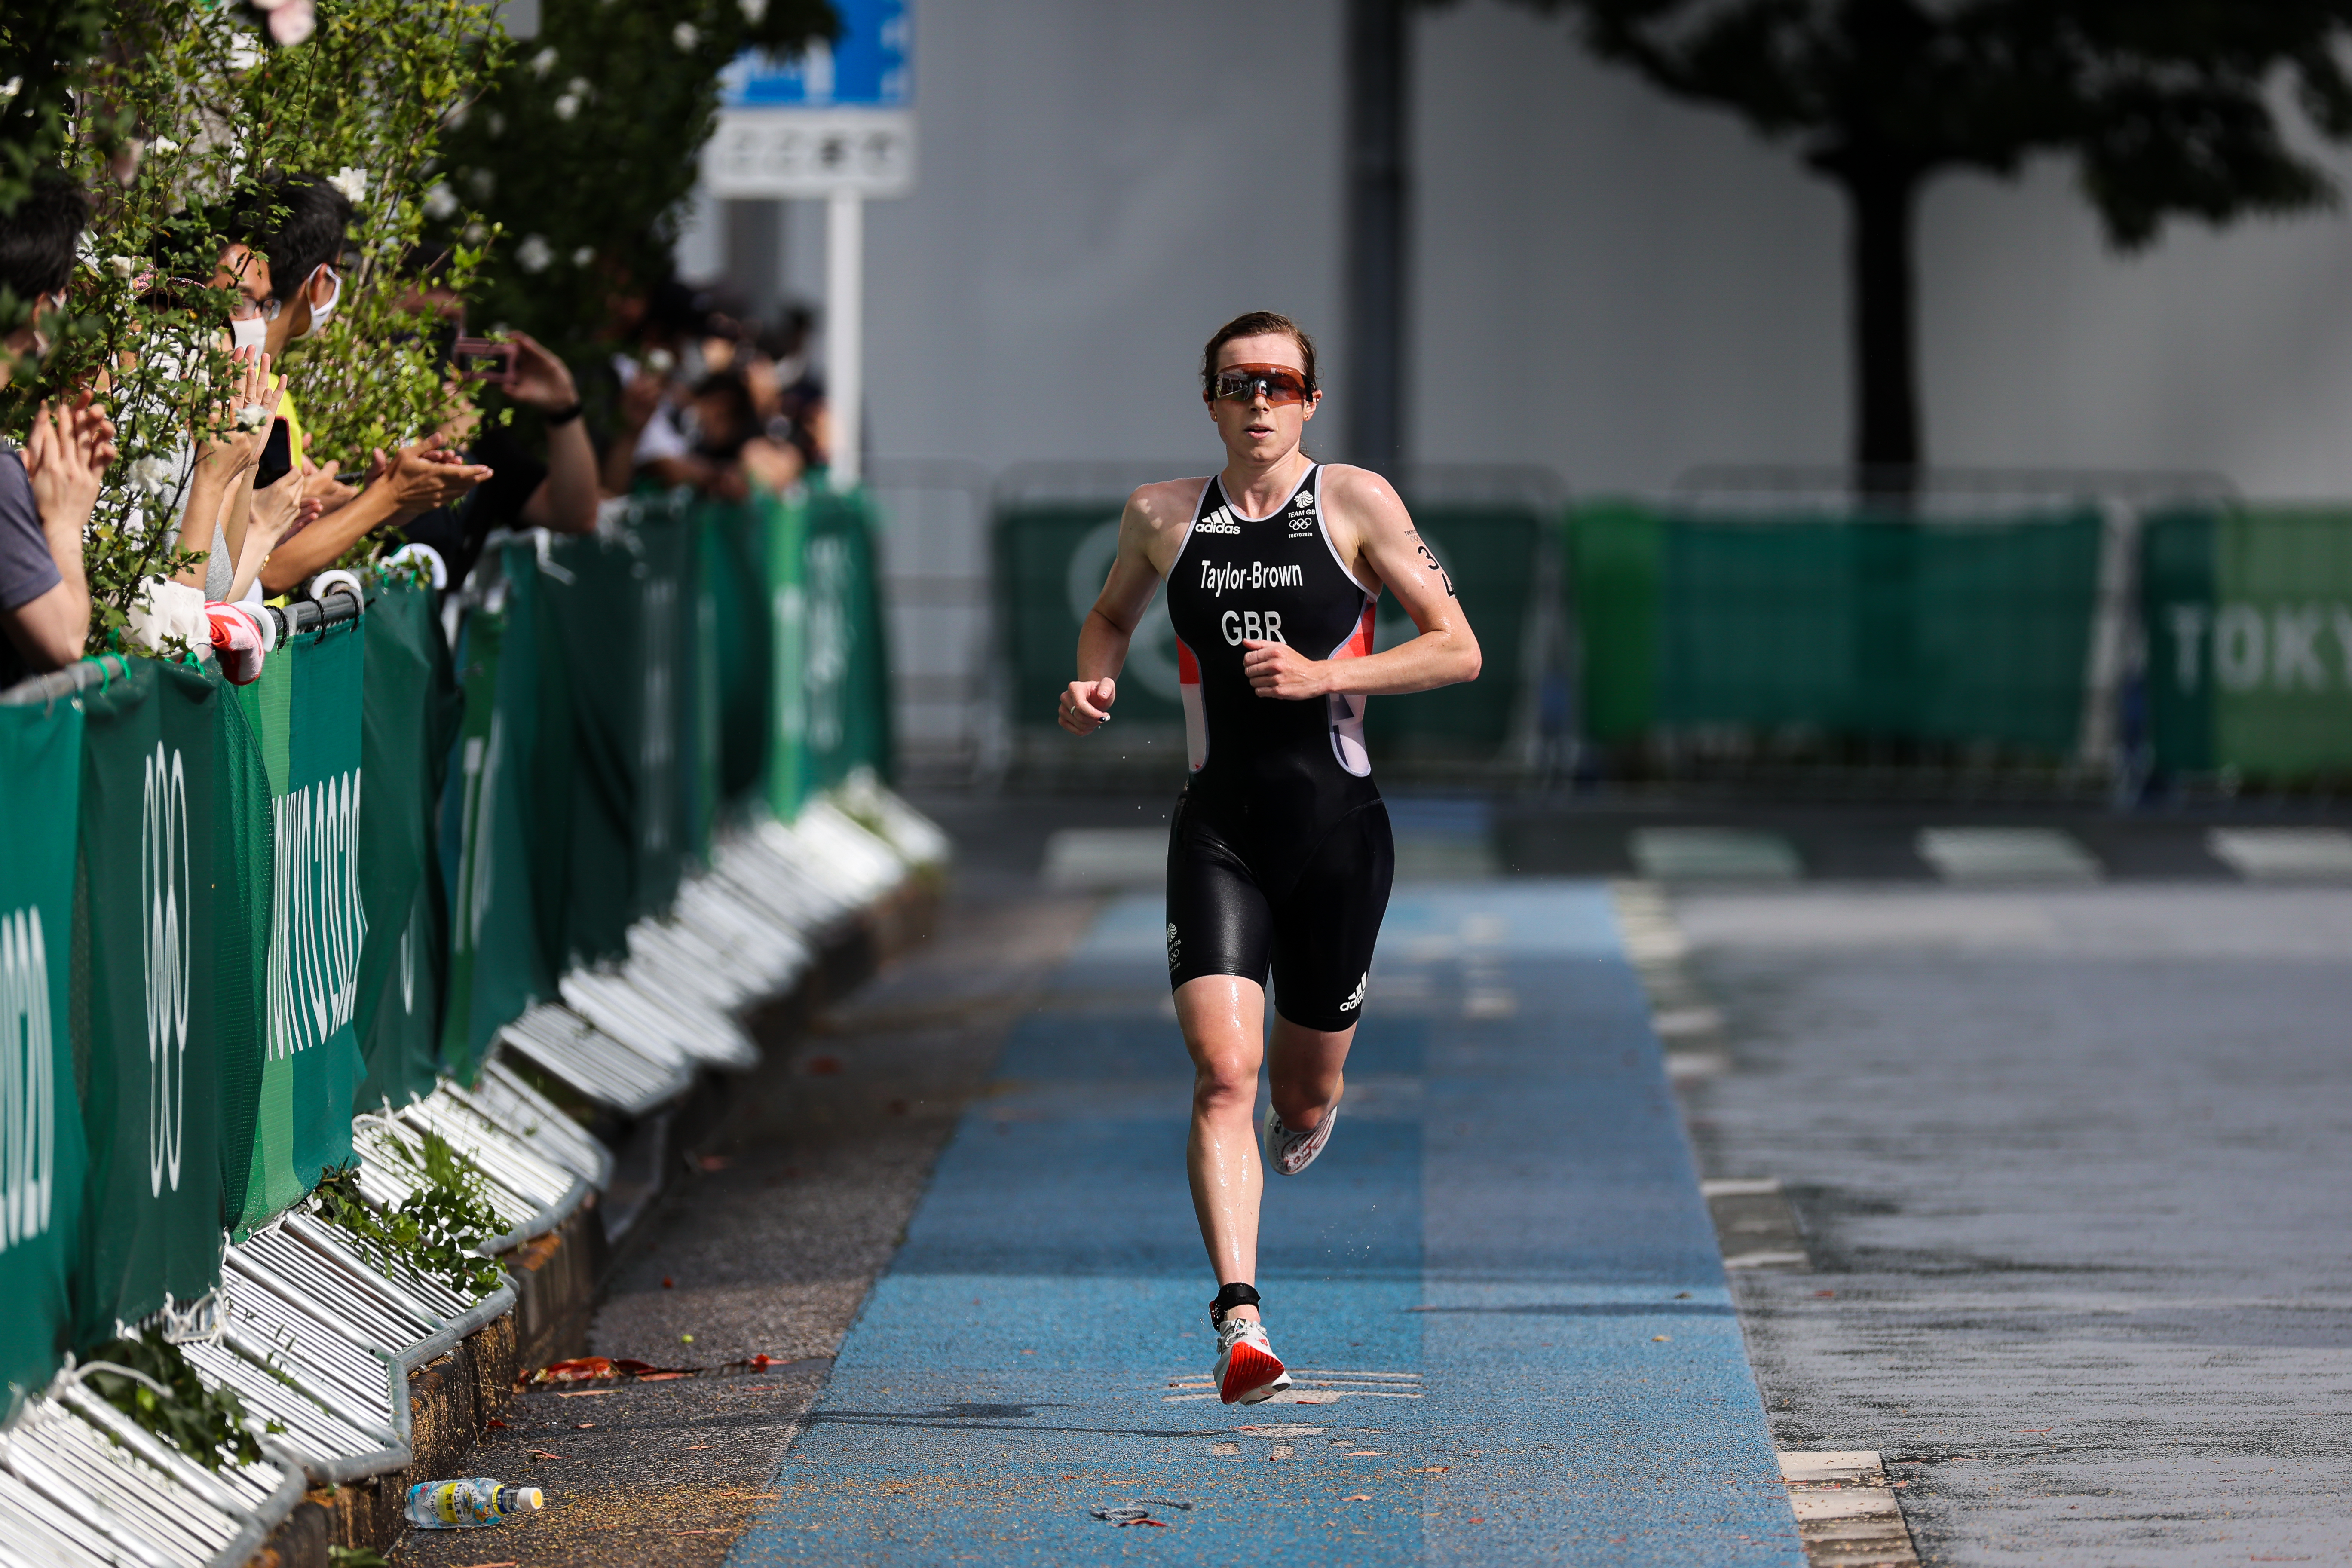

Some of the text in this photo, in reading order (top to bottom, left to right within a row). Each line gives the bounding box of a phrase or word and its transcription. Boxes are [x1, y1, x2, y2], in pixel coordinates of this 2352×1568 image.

[1195, 522, 1240, 535] adidas
[1288, 510, 1305, 518] TEAM
[1201, 560, 1303, 597] Taylor-Brown
[1222, 610, 1287, 646] GBR
[0, 903, 55, 1252] 020
[430, 1490, 440, 1518] LEMON
[454, 1484, 464, 1521] キリンレモン
